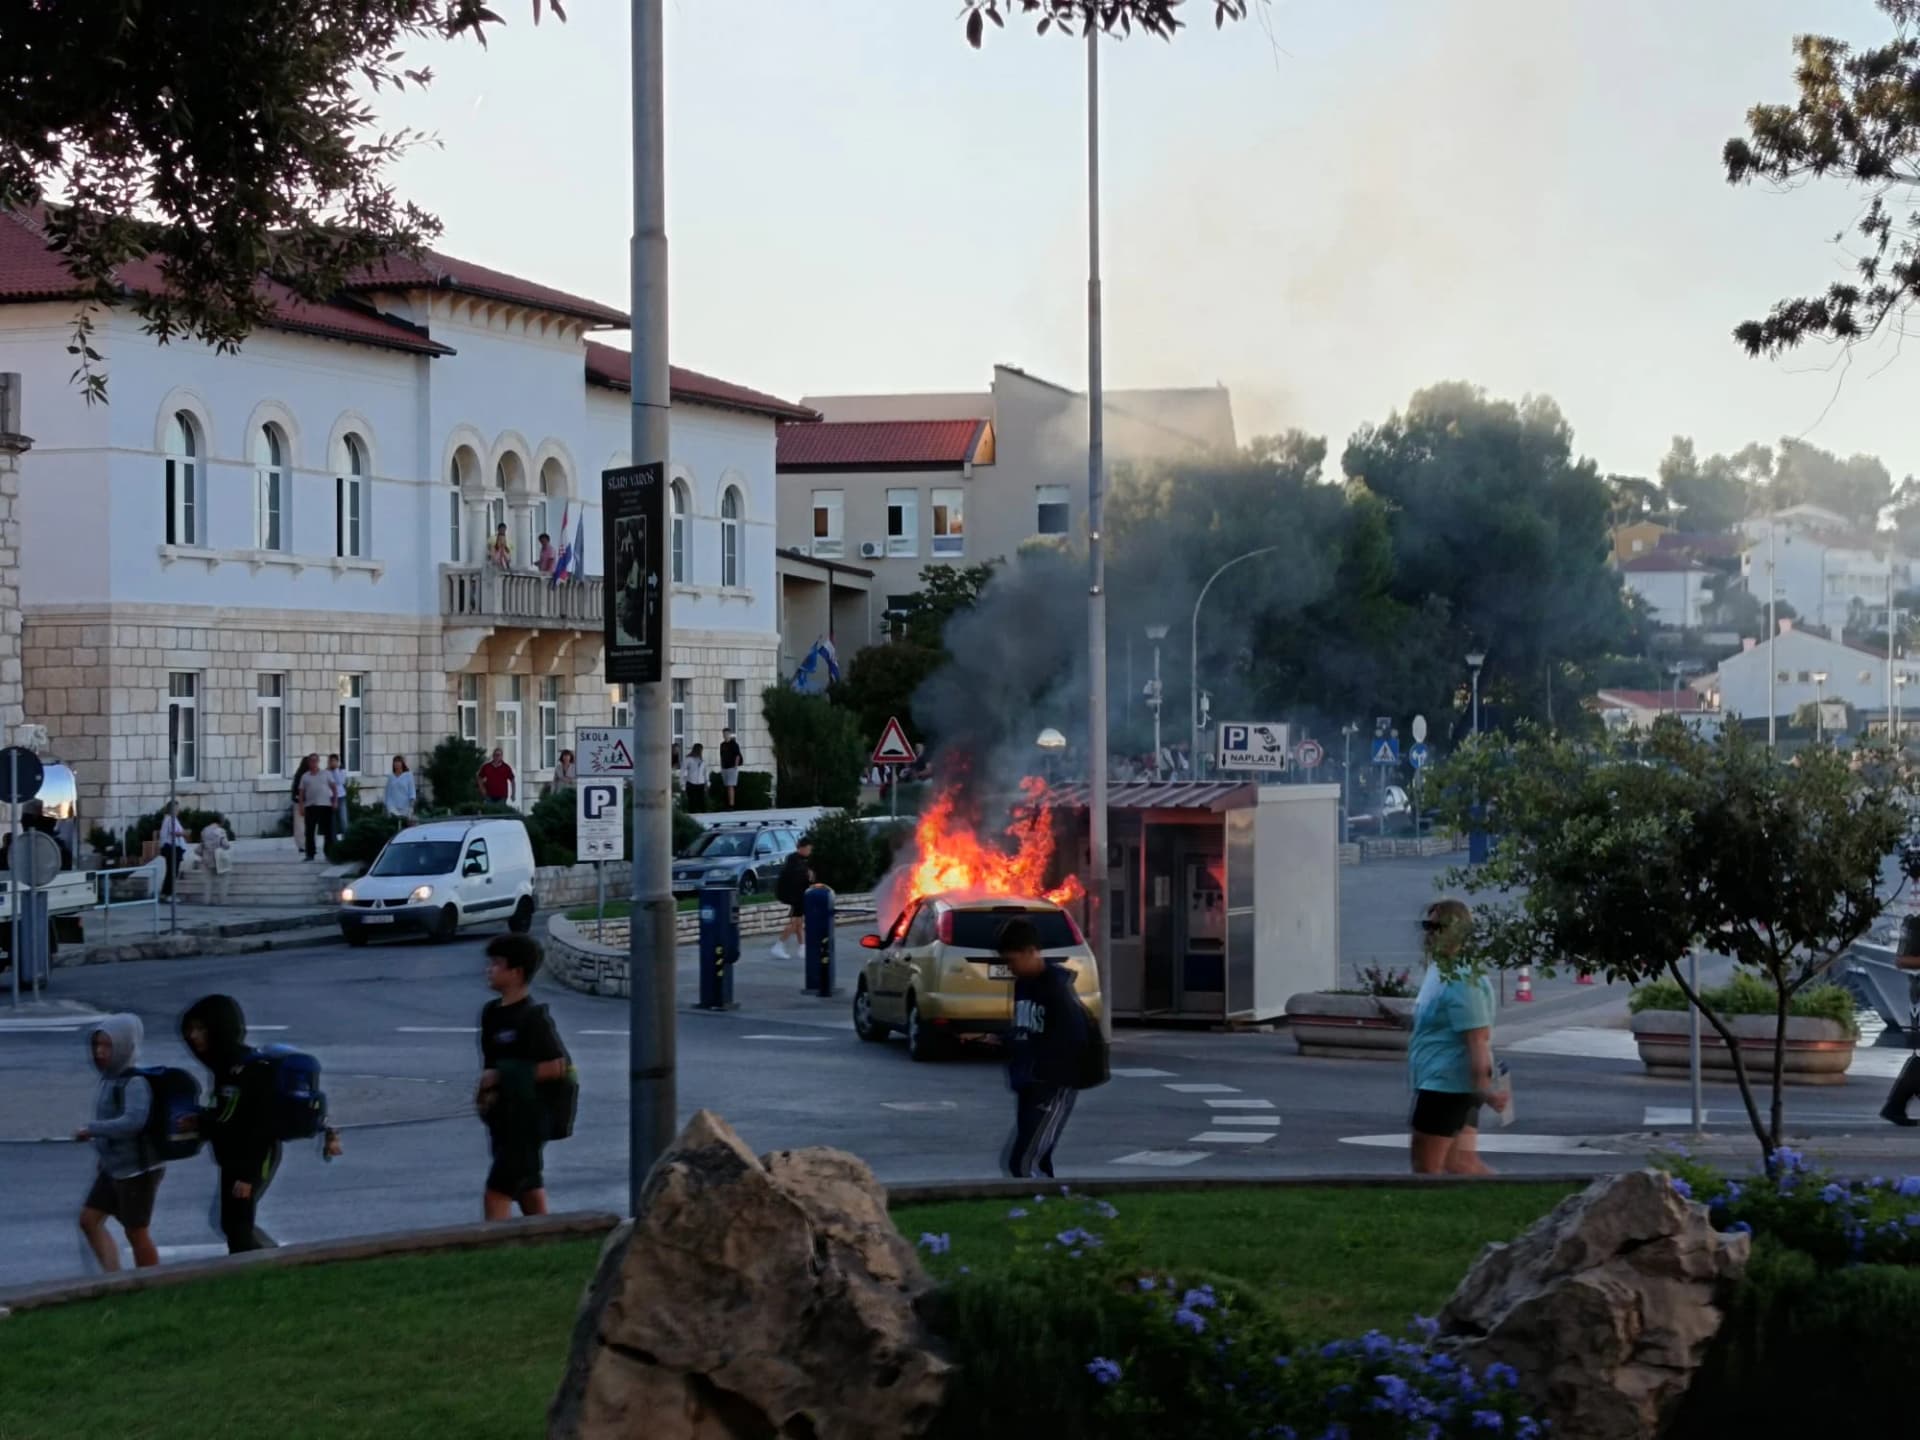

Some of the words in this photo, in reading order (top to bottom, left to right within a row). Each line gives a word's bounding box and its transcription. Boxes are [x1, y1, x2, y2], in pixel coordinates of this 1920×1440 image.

[580, 731, 609, 742] ŠKOLA
[1229, 728, 1245, 749] P
[1230, 753, 1277, 763] NAPLATA
[590, 789, 611, 816] P
